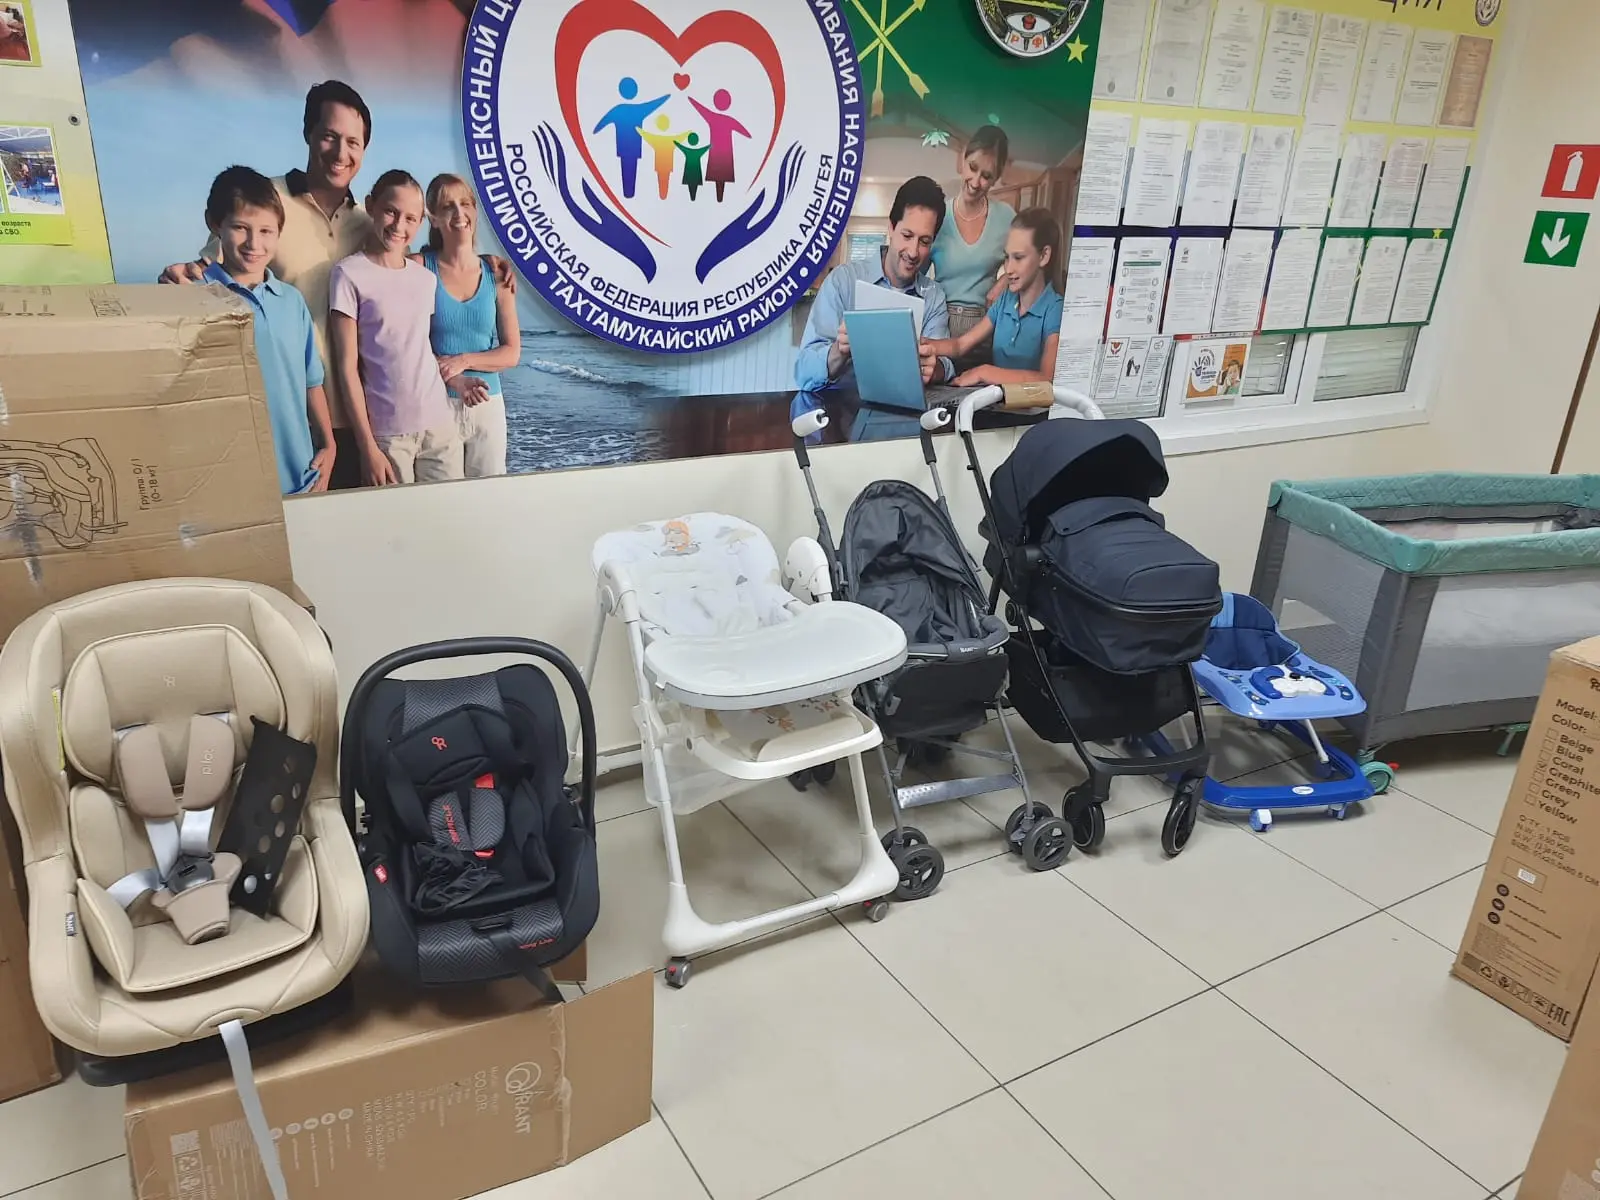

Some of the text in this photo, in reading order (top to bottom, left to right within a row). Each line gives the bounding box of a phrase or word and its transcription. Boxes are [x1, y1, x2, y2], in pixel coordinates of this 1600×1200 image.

[468, 24, 540, 265] КОМПЛЕКСНЫЙ
[805, 113, 860, 265] НАСЕЛЕНИЯ
[505, 143, 833, 319] РОССИЙСКАЯ ФЕДЕРАЦИЯ РЕСПУБЛИКА АДЫГЕЯ
[549, 270, 799, 350] ТАХТАМУКАЙСКИЙ РАЙОН
[1556, 698, 1598, 721] Model:
[1551, 713, 1588, 735] Color:
[1556, 745, 1584, 763] Blue
[1559, 734, 1594, 754] Beige
[1552, 756, 1584, 776] Coral
[1541, 789, 1569, 809] Grey
[1545, 778, 1581, 800] Green
[1537, 800, 1579, 825] Yellow
